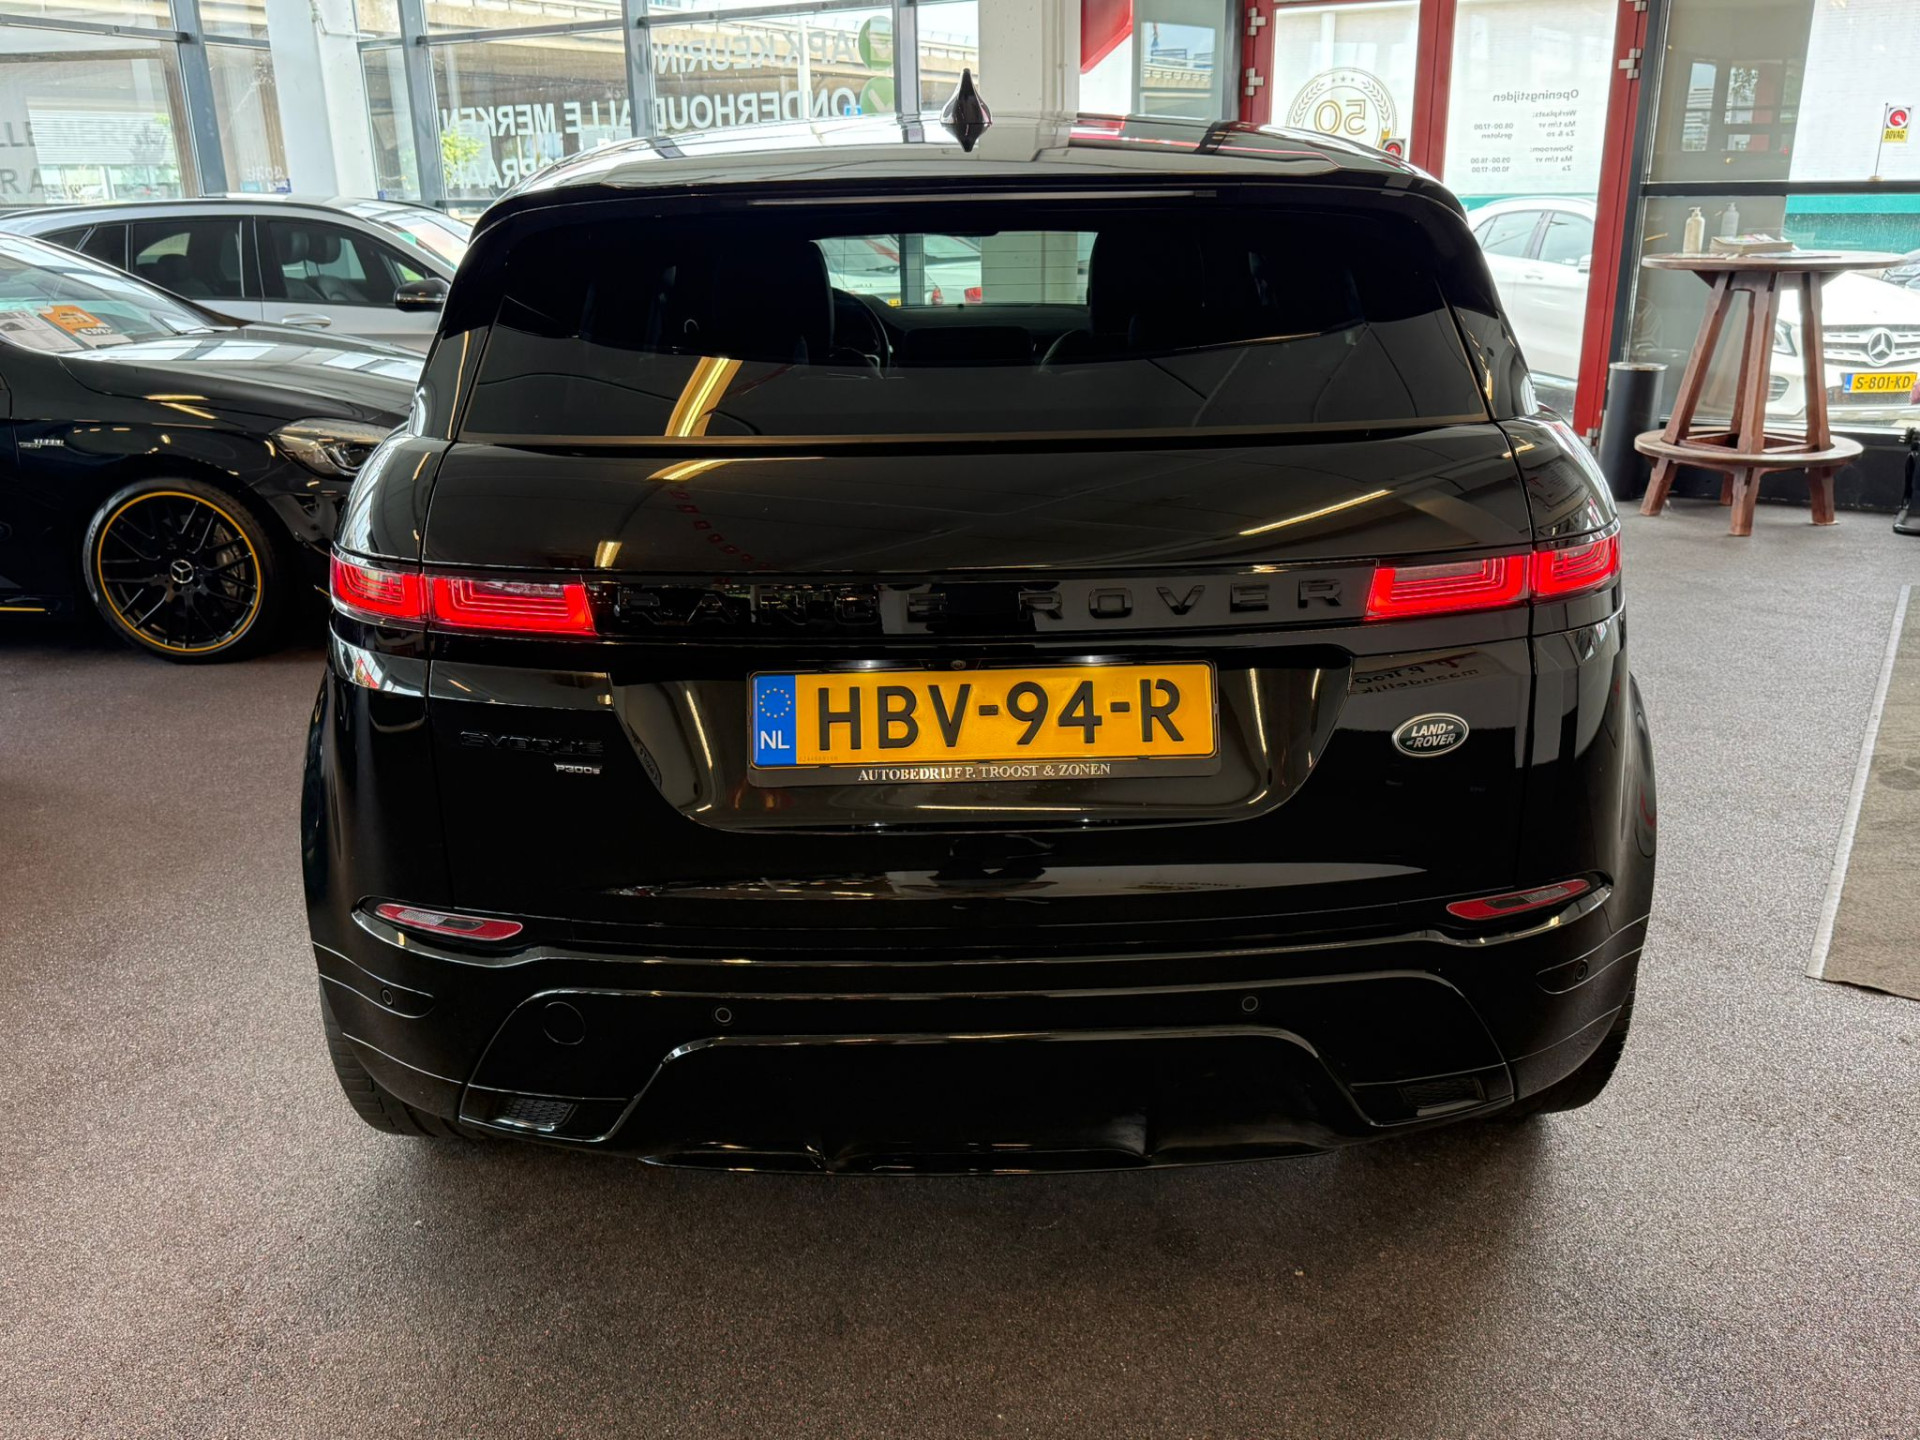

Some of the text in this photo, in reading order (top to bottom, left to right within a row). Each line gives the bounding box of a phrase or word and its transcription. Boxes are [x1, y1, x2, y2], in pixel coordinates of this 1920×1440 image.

[1855, 376, 1911, 389] S-801-KD
[616, 579, 1342, 625] RANGE ROVER
[817, 678, 1185, 751] HBV-94-R
[1411, 723, 1447, 738] LAND
[760, 730, 790, 750] NL
[1413, 733, 1456, 748] ROVER
[858, 763, 1111, 781] AUTOBEDRIJF P. TROOST & ZONEN
